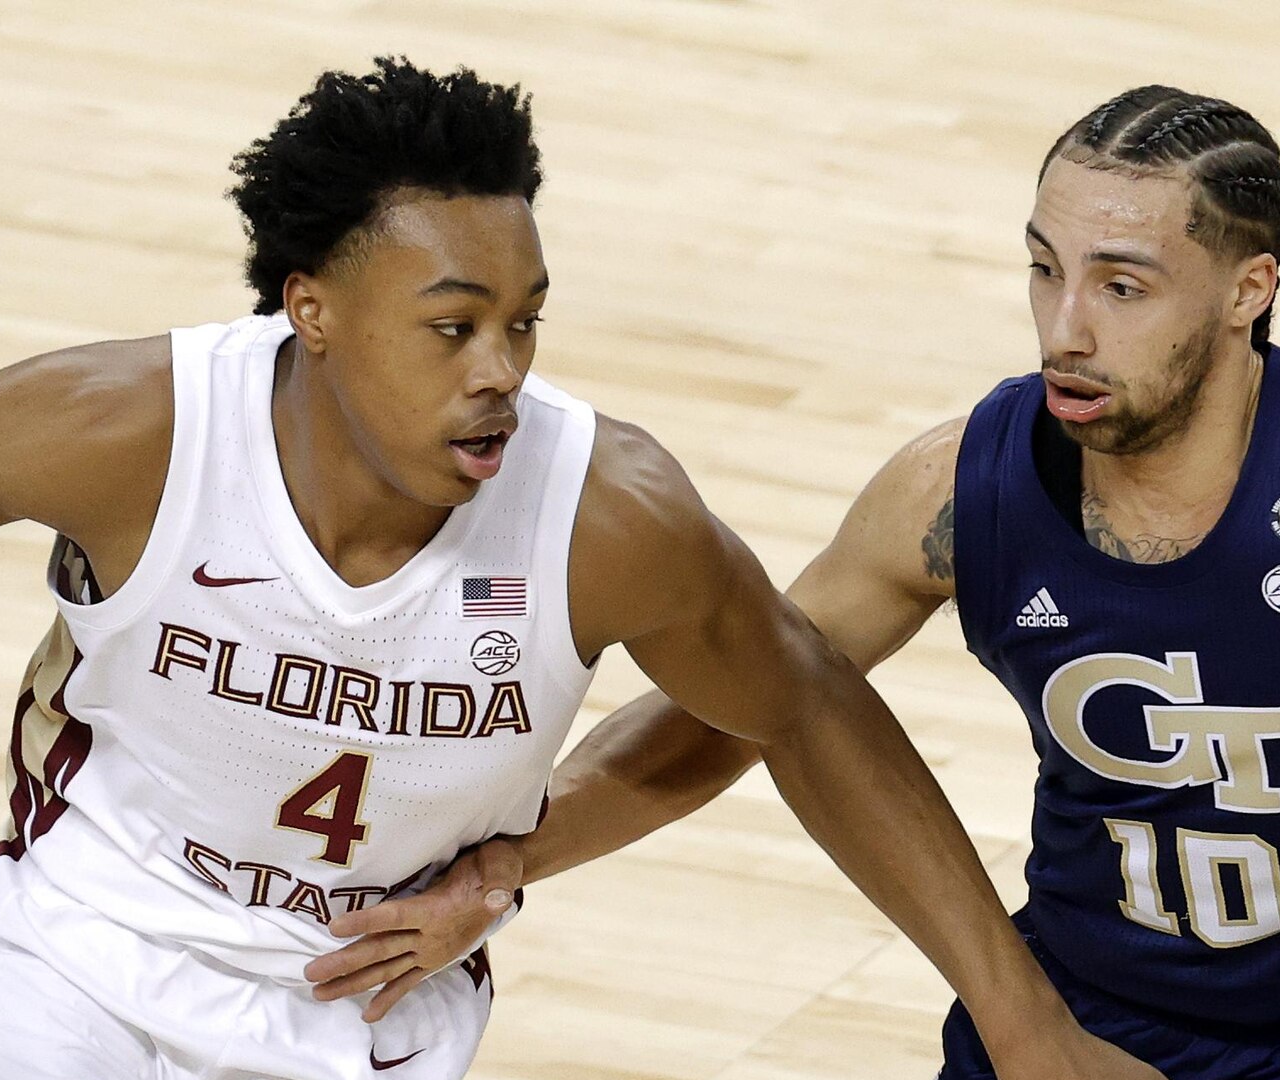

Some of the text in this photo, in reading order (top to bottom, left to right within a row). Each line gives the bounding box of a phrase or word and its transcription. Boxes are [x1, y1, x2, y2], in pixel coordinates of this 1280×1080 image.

[477, 645, 518, 656] ACC
[1016, 612, 1069, 628] adidas
[149, 621, 532, 739] FLORIDA
[274, 749, 374, 869] 4
[183, 837, 432, 926] STAT
